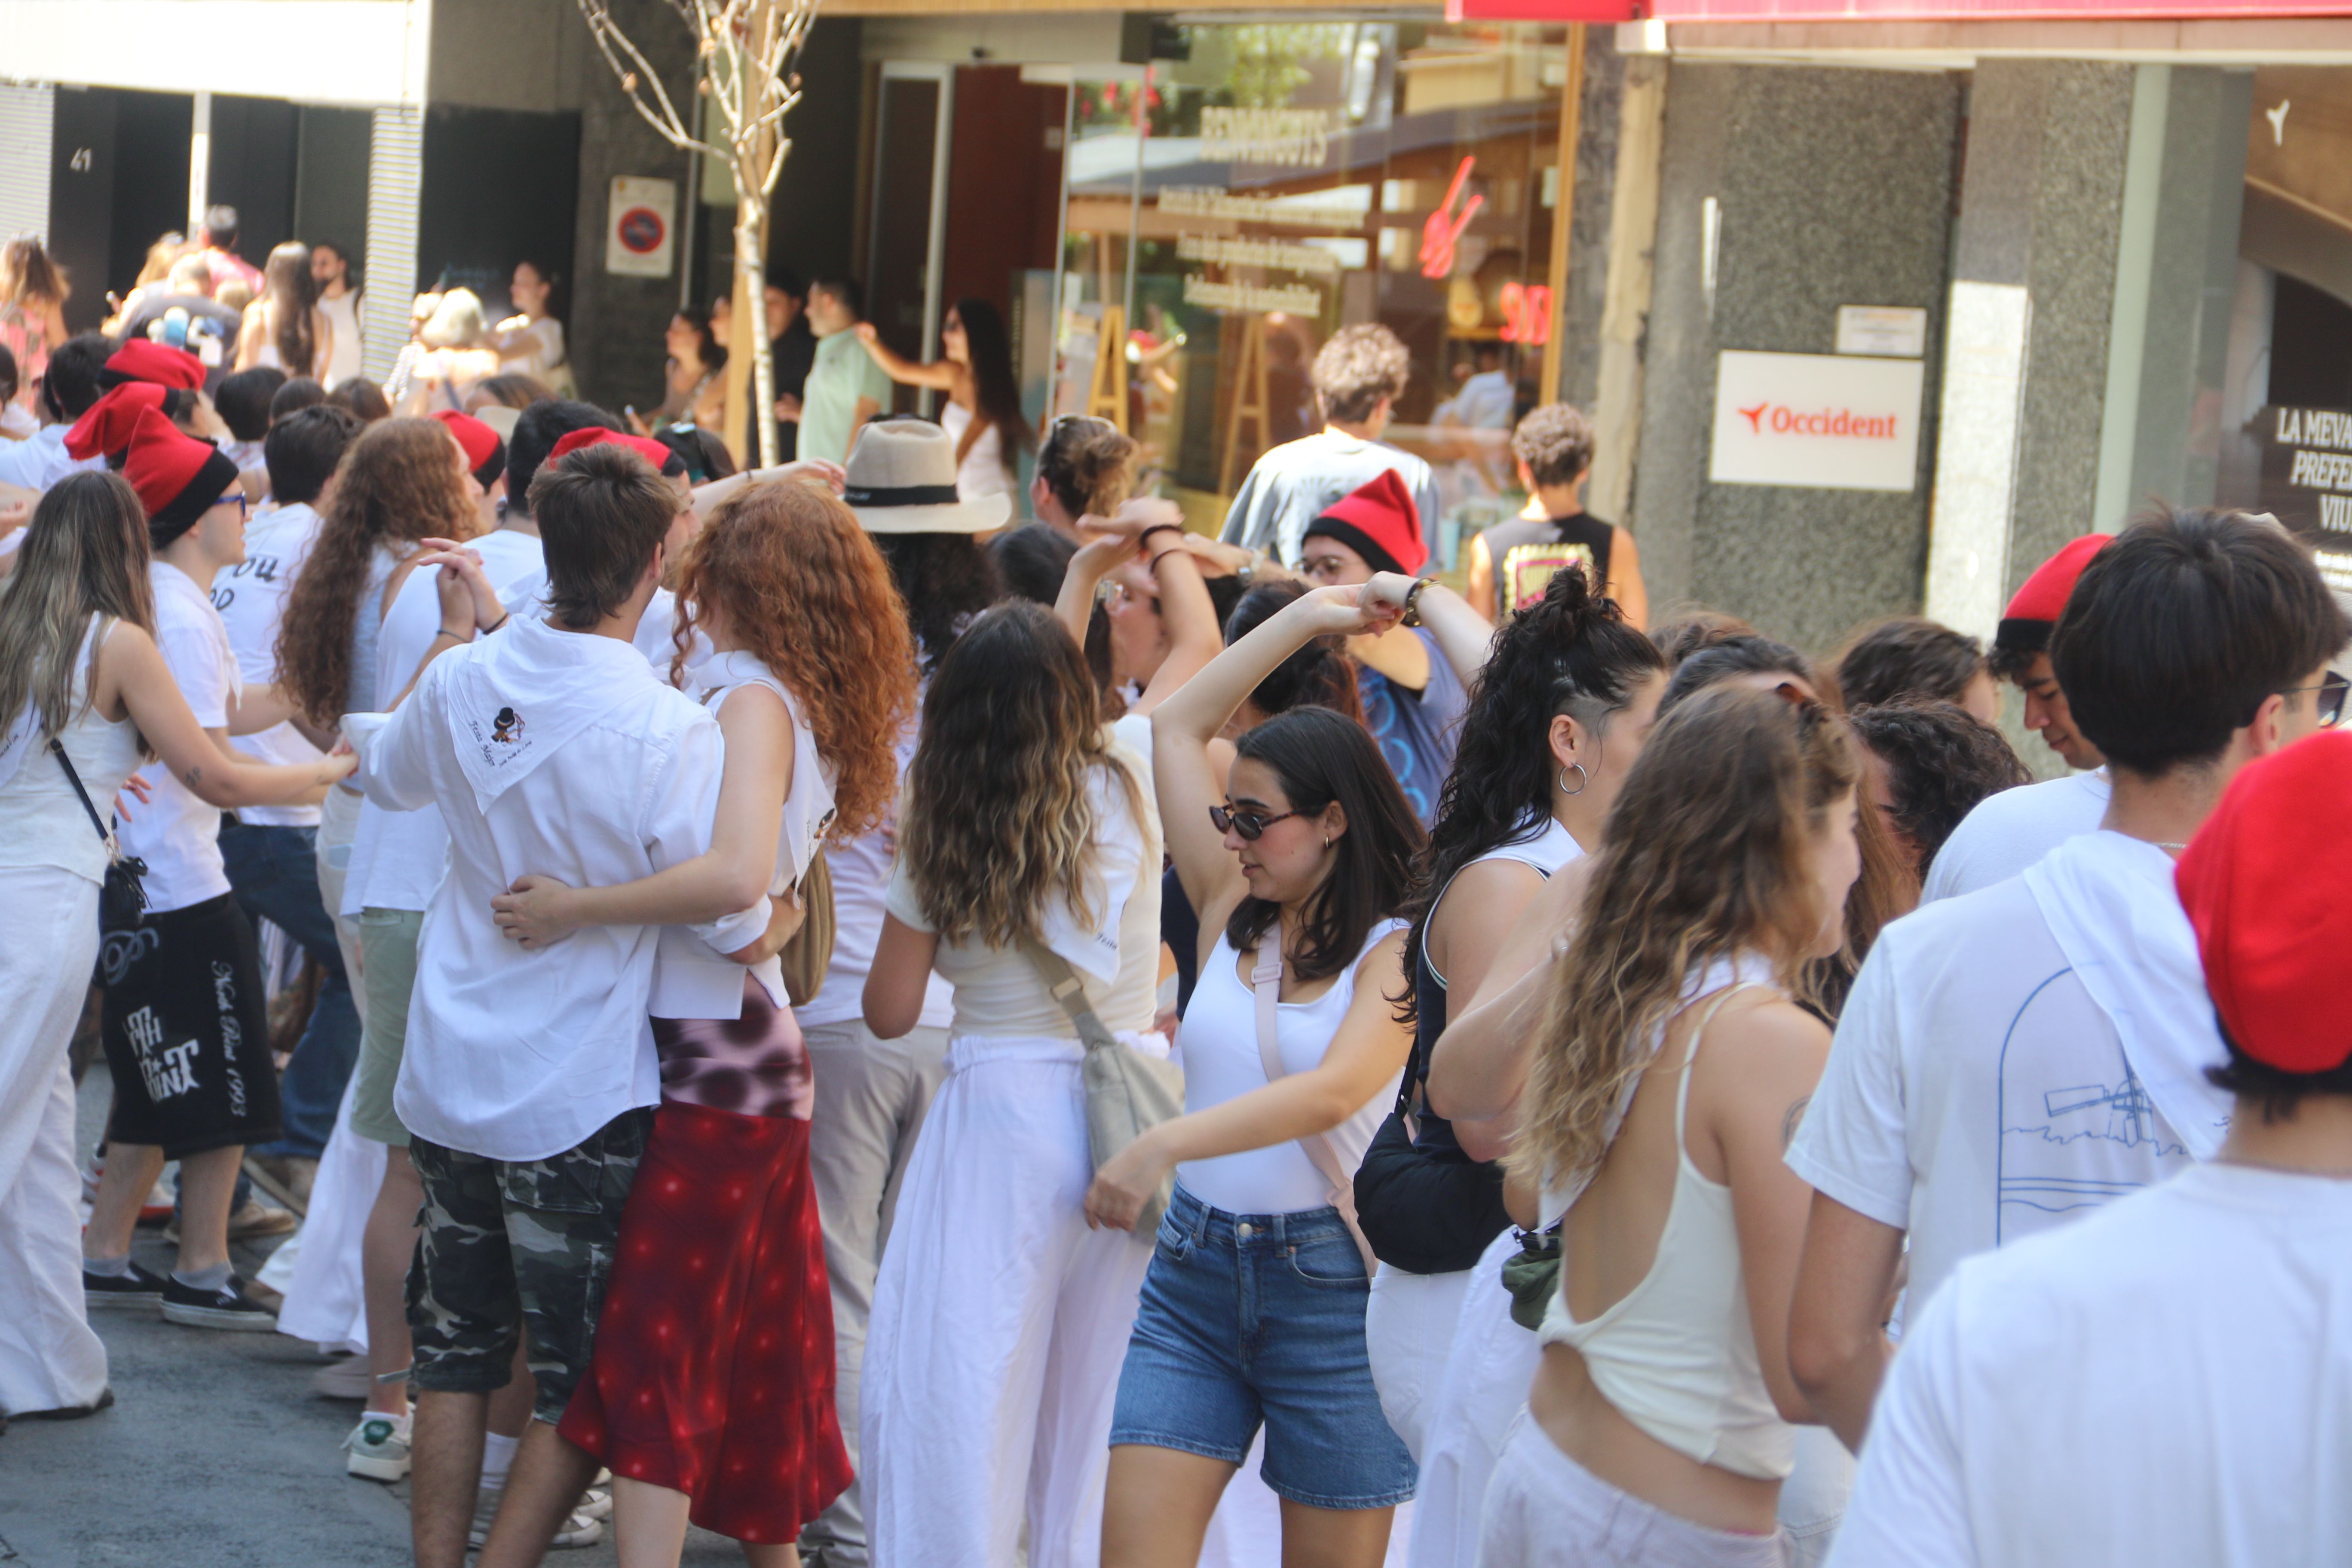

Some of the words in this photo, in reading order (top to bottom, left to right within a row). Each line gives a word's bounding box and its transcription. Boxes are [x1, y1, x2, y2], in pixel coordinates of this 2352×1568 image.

[1772, 406, 1895, 439] Occident
[2276, 407, 2301, 444] LA
[2290, 450, 2352, 491] PREFE
[227, 1068, 247, 1117] 1993
